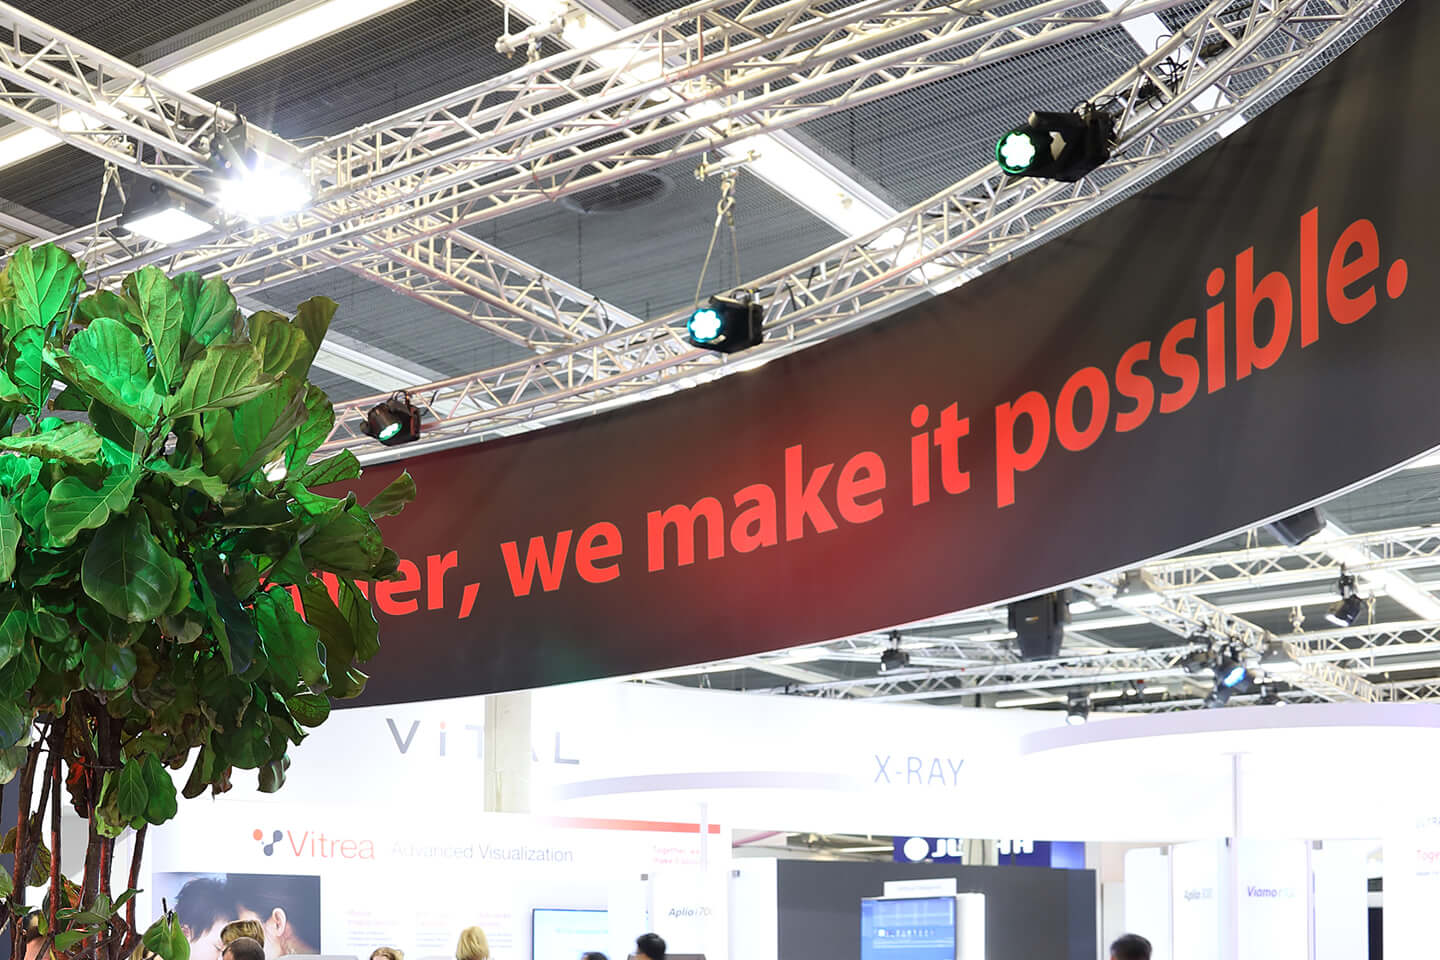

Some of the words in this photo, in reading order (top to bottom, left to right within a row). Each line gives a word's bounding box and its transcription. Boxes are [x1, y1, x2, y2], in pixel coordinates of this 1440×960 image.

[500, 520, 622, 598] we
[646, 443, 886, 573] make
[909, 401, 970, 508] it
[993, 207, 1410, 509] possible.
[385, 716, 581, 766] ViTL
[874, 754, 964, 787] X-RAY
[287, 830, 375, 861] Vitrea
[392, 841, 473, 860] Advanced
[478, 843, 574, 863] Visualization
[1247, 885, 1277, 898] Viamo
[668, 906, 694, 918] Aplio
